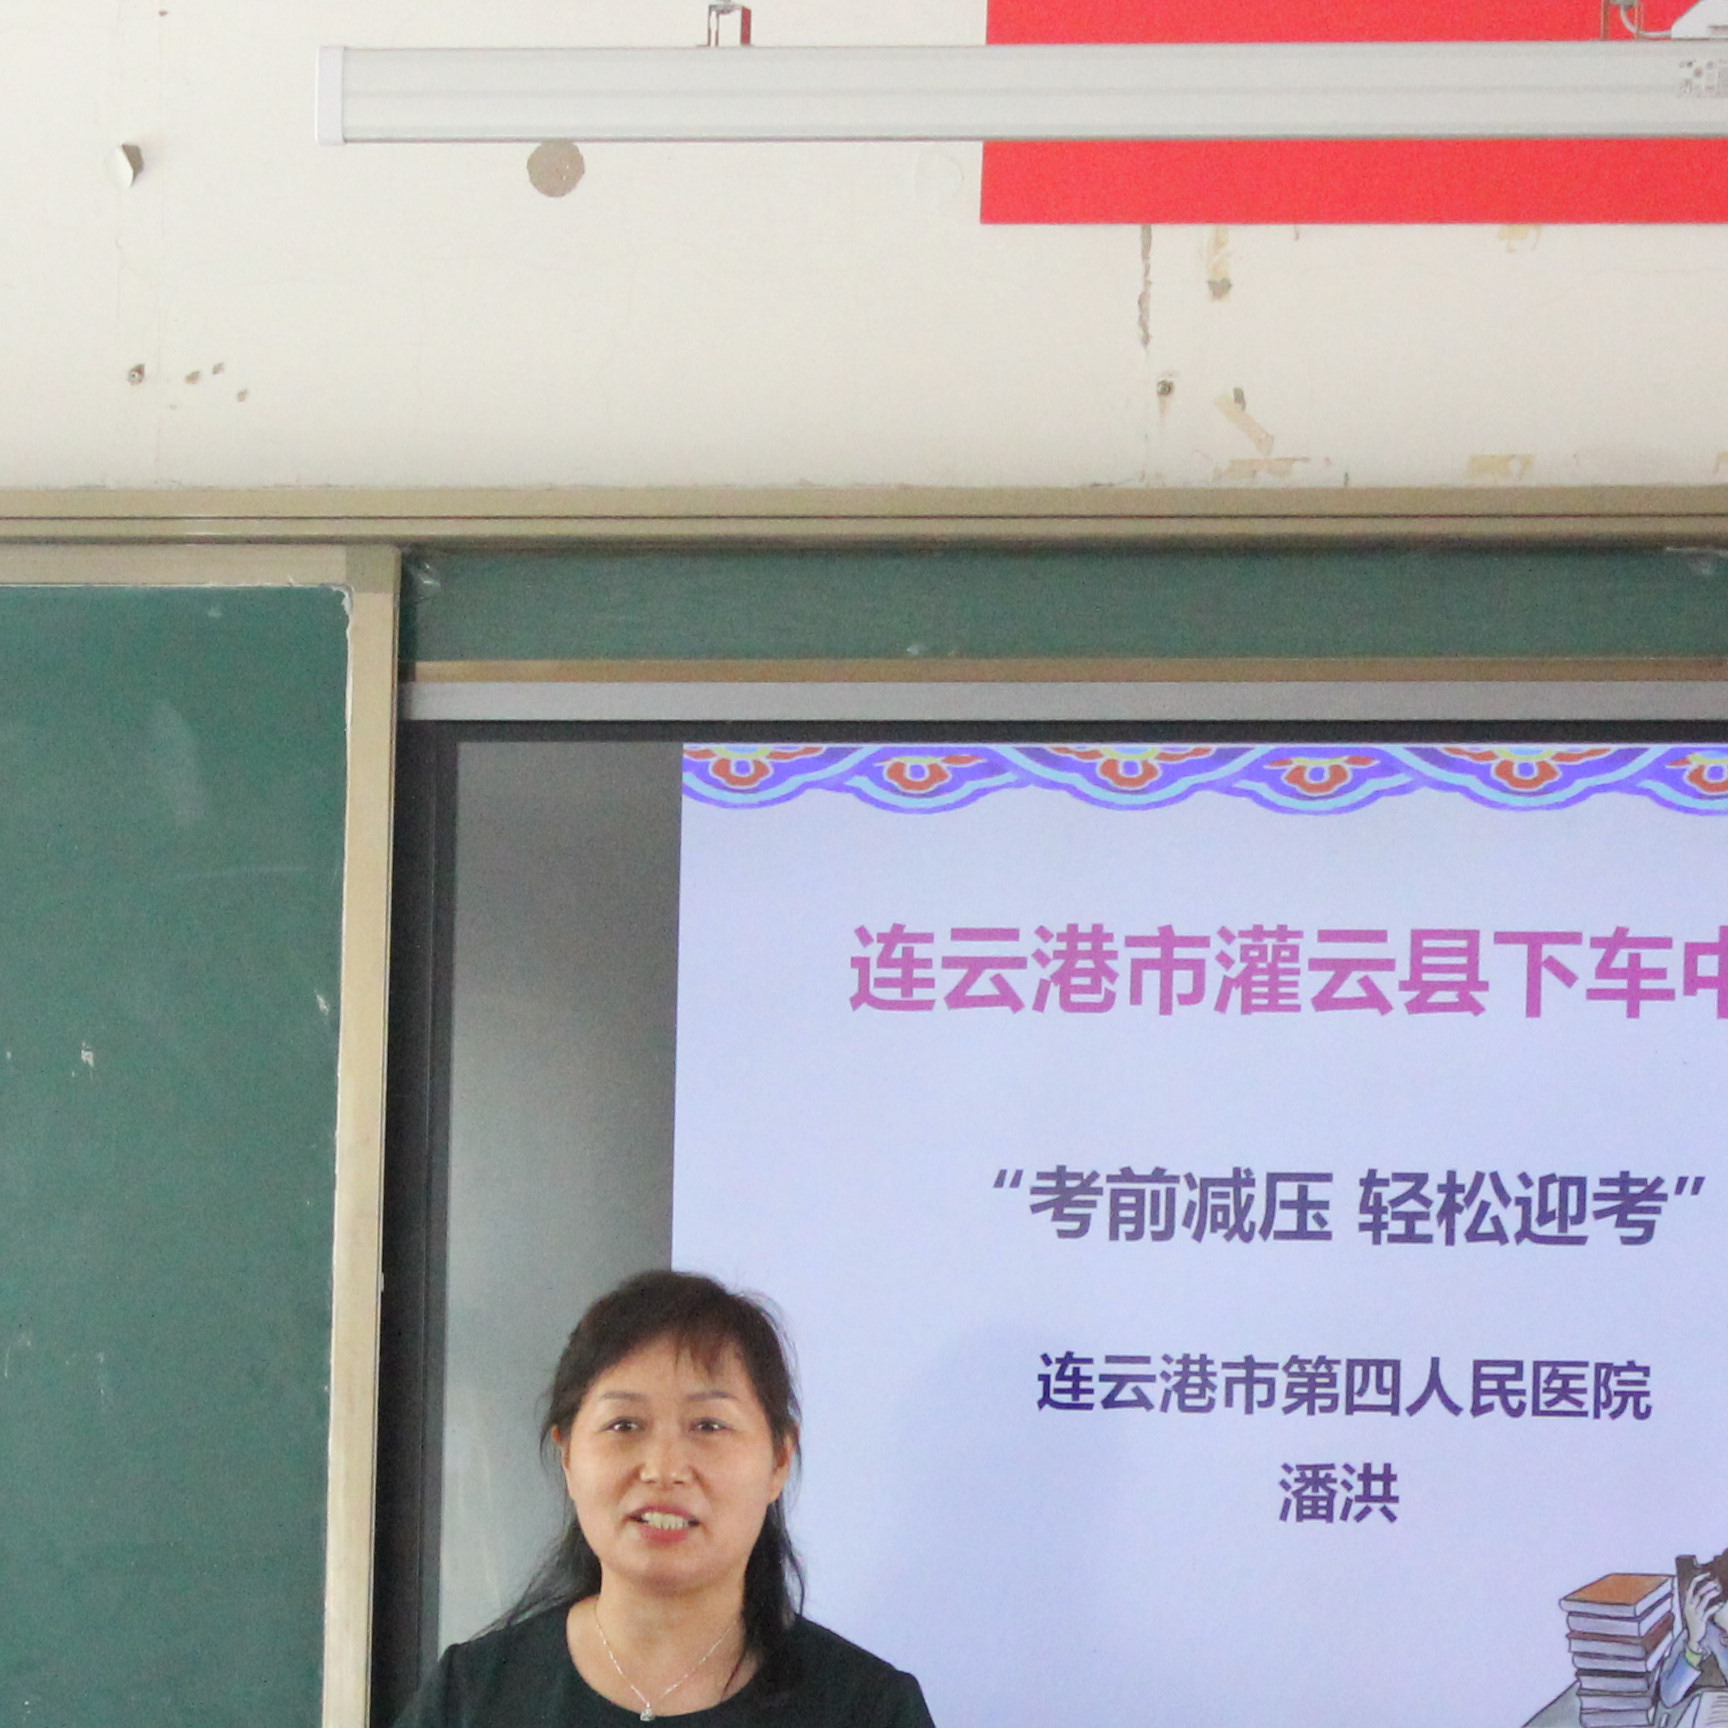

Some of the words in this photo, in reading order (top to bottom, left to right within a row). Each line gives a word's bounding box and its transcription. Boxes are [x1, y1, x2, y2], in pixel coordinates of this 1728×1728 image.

[1036, 1350, 1653, 1421] 连云港市第四人民医院
[1278, 1461, 1400, 1524] 潘洪
